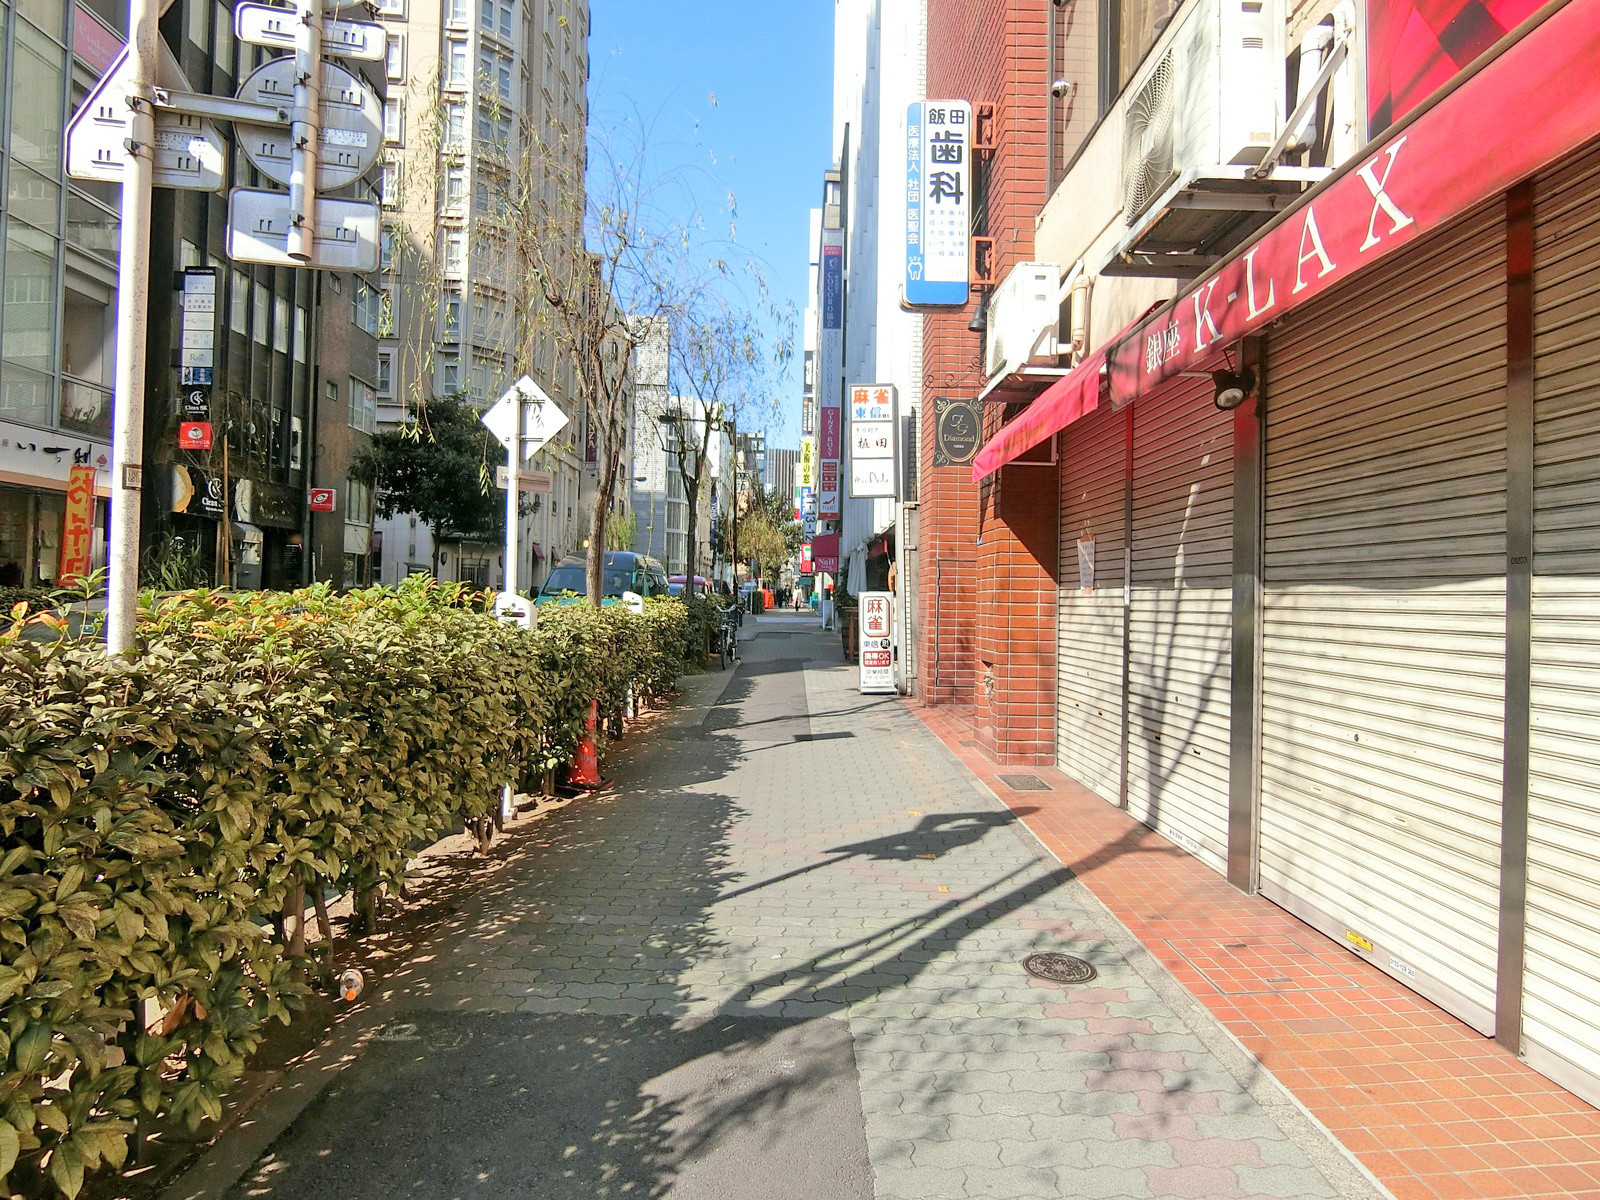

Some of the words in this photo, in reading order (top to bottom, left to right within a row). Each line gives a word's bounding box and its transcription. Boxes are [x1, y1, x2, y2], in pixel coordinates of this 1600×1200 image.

[928, 108, 965, 125] 飯田
[907, 125, 920, 173] 医療法人
[929, 130, 964, 206] 歯科
[907, 178, 920, 203] 社団
[1192, 136, 1414, 354] K-LAX
[1145, 318, 1181, 375] 銀座
[853, 388, 890, 404] 麻雀
[943, 434, 975, 442] Diamond
[818, 558, 834, 566] Nail
[867, 599, 883, 630] 麻雀
